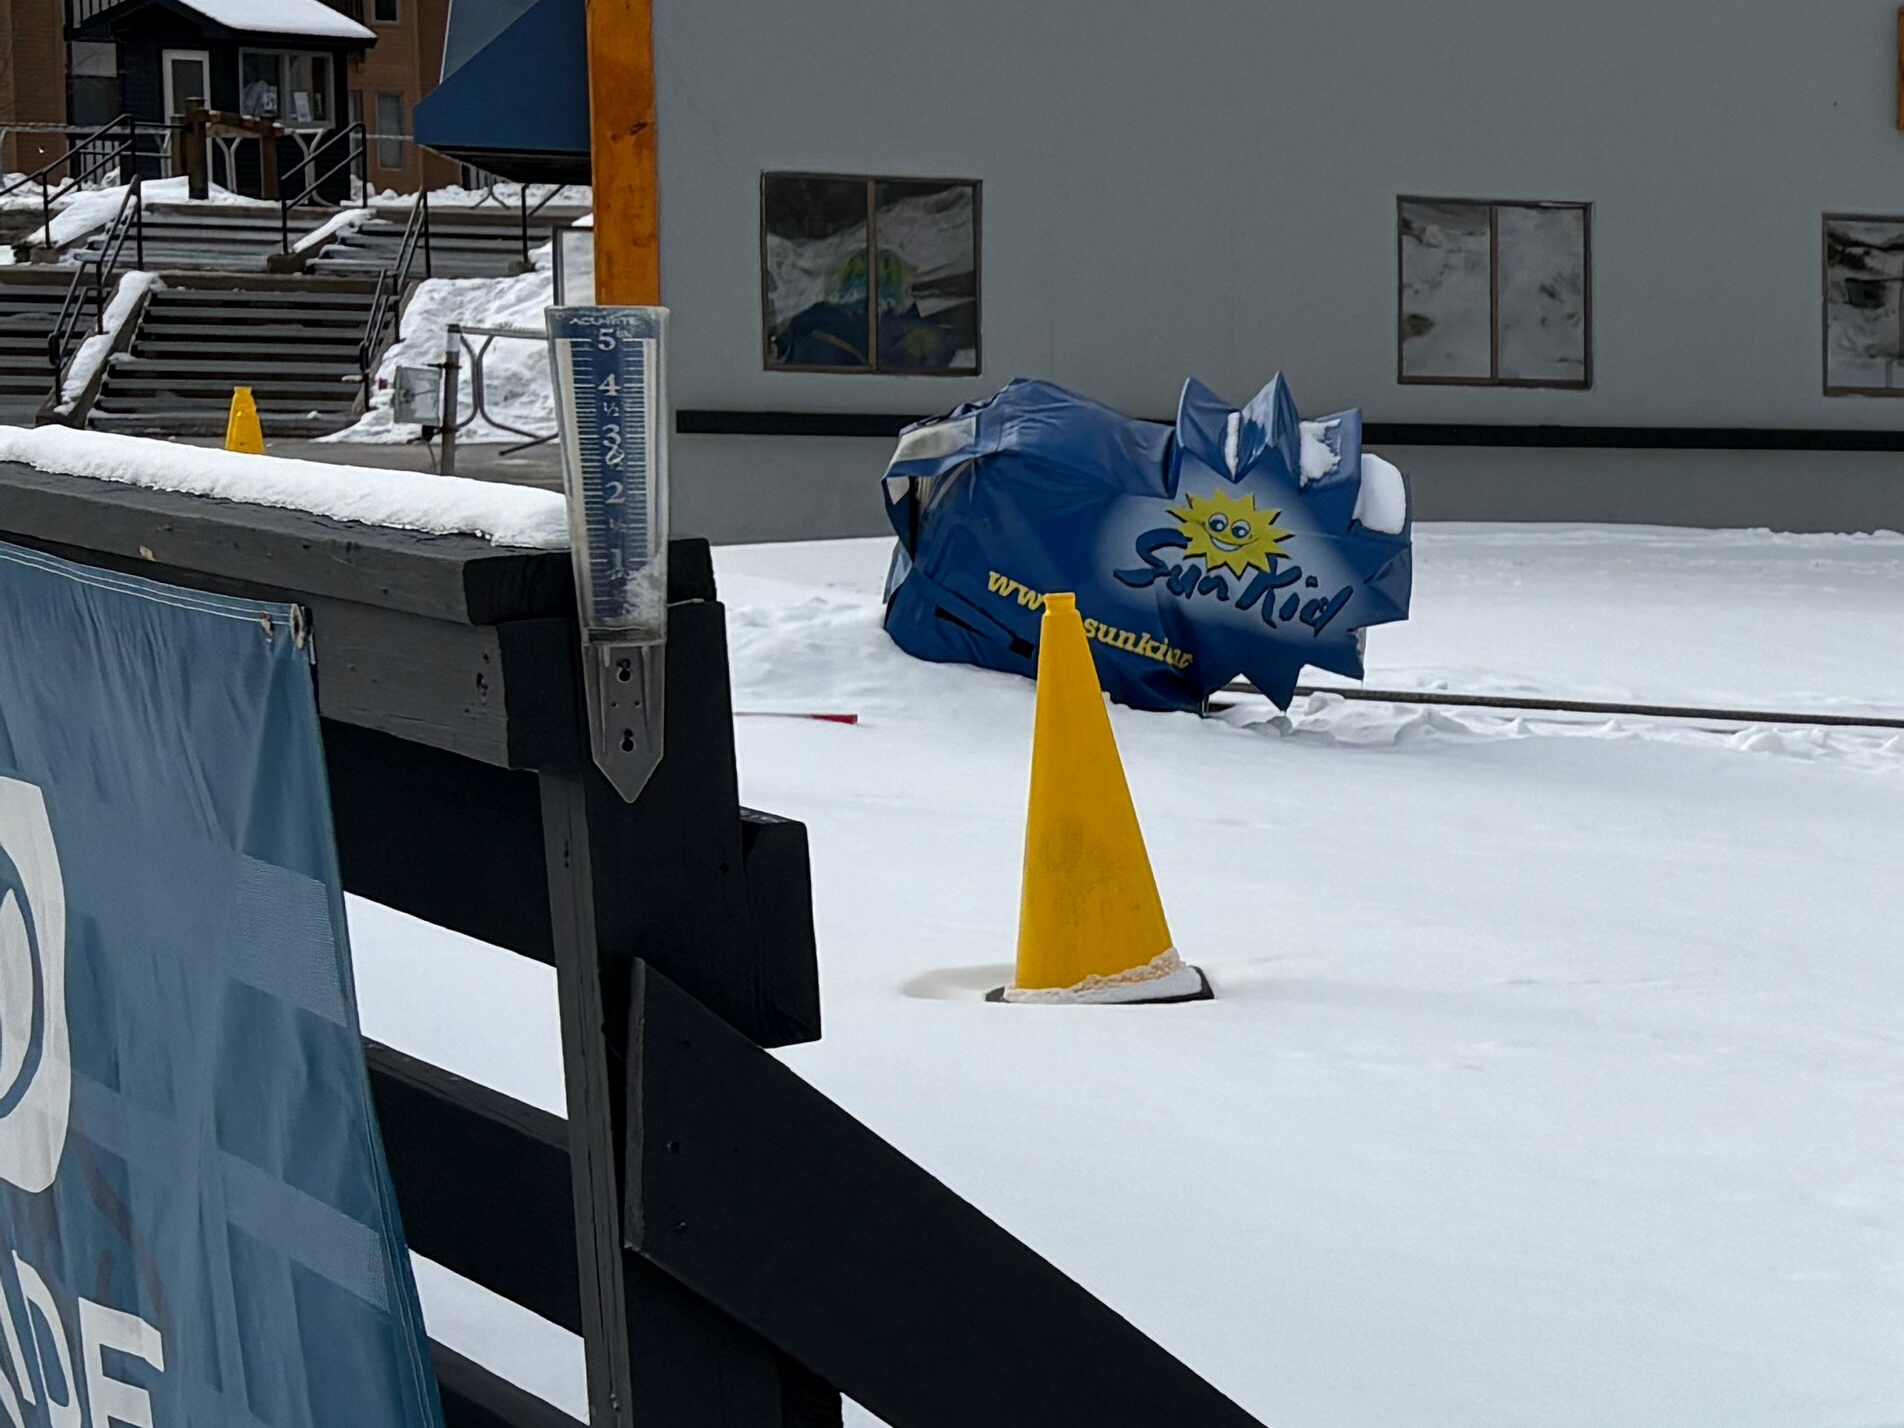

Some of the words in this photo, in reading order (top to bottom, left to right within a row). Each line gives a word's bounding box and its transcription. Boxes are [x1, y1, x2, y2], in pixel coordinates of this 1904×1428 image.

[598, 328, 616, 351] 5
[598, 373, 621, 396] 4
[602, 423, 622, 447] 3
[605, 481, 626, 504] 2
